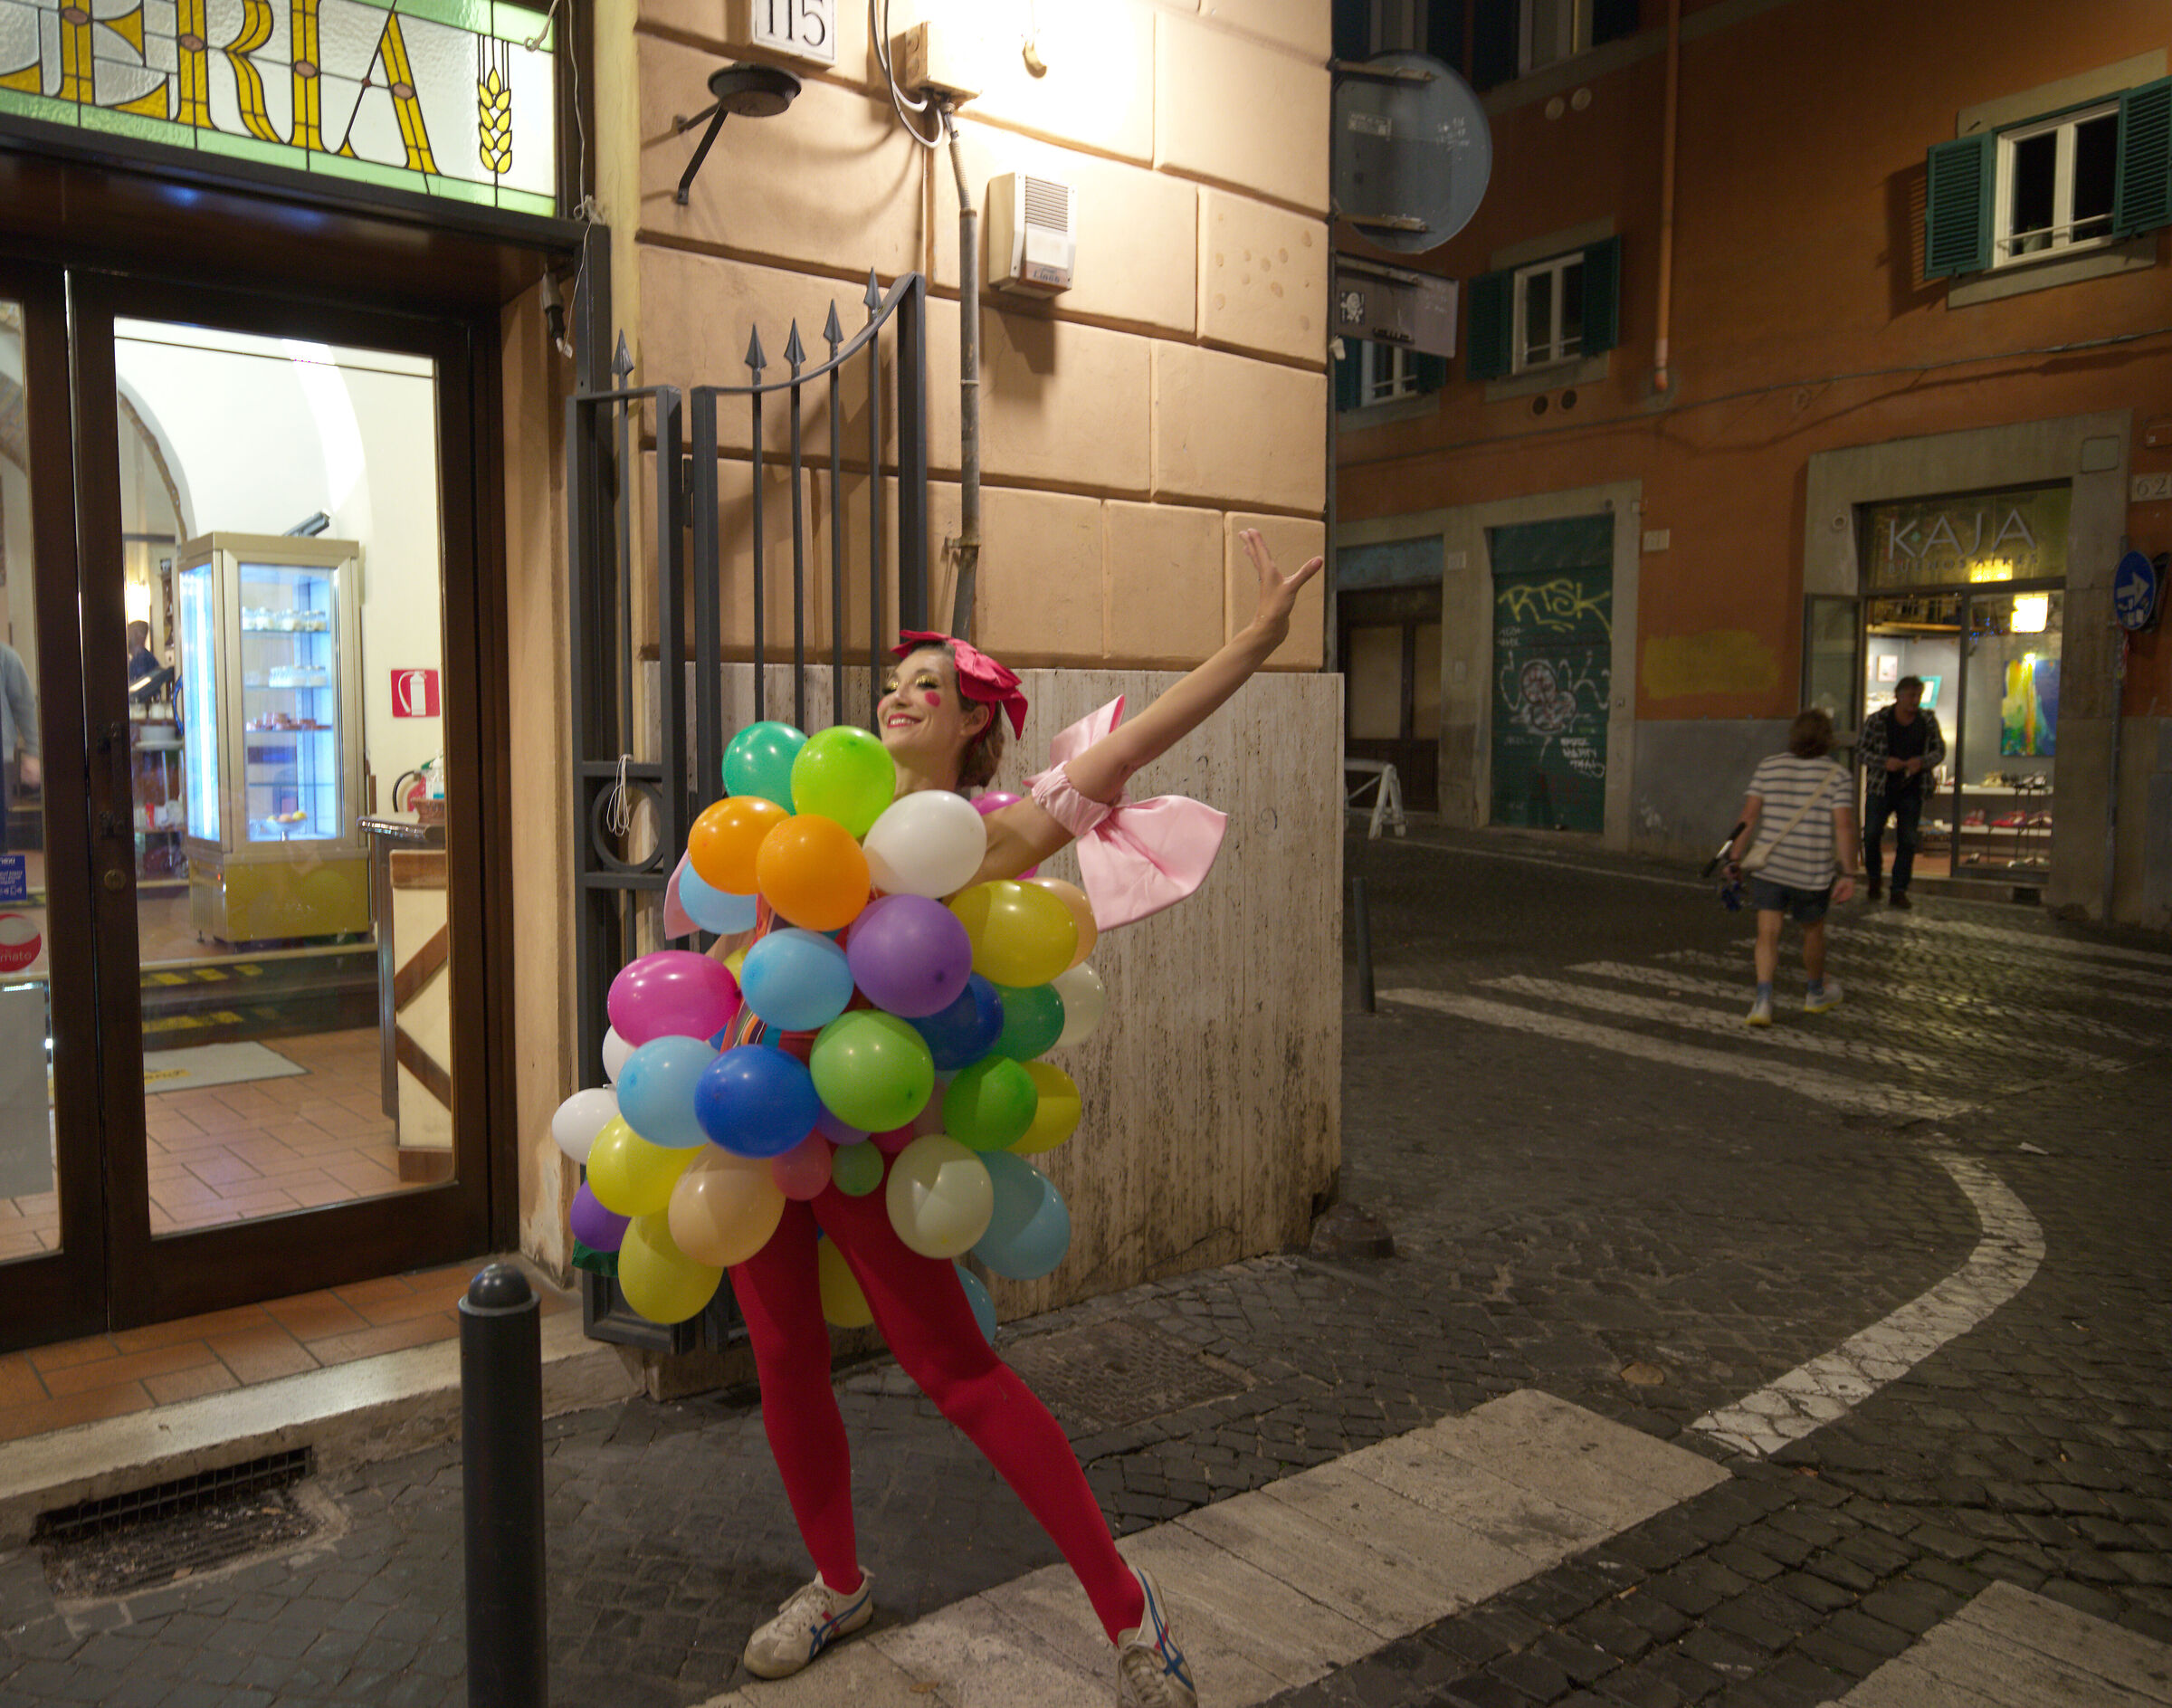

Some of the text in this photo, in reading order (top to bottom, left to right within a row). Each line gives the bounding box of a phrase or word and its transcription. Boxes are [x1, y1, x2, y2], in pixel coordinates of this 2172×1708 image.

[766, 0, 826, 47] 115
[1889, 508, 2037, 560] KAJA
[1888, 553, 2038, 574] BUENOS AIRES
